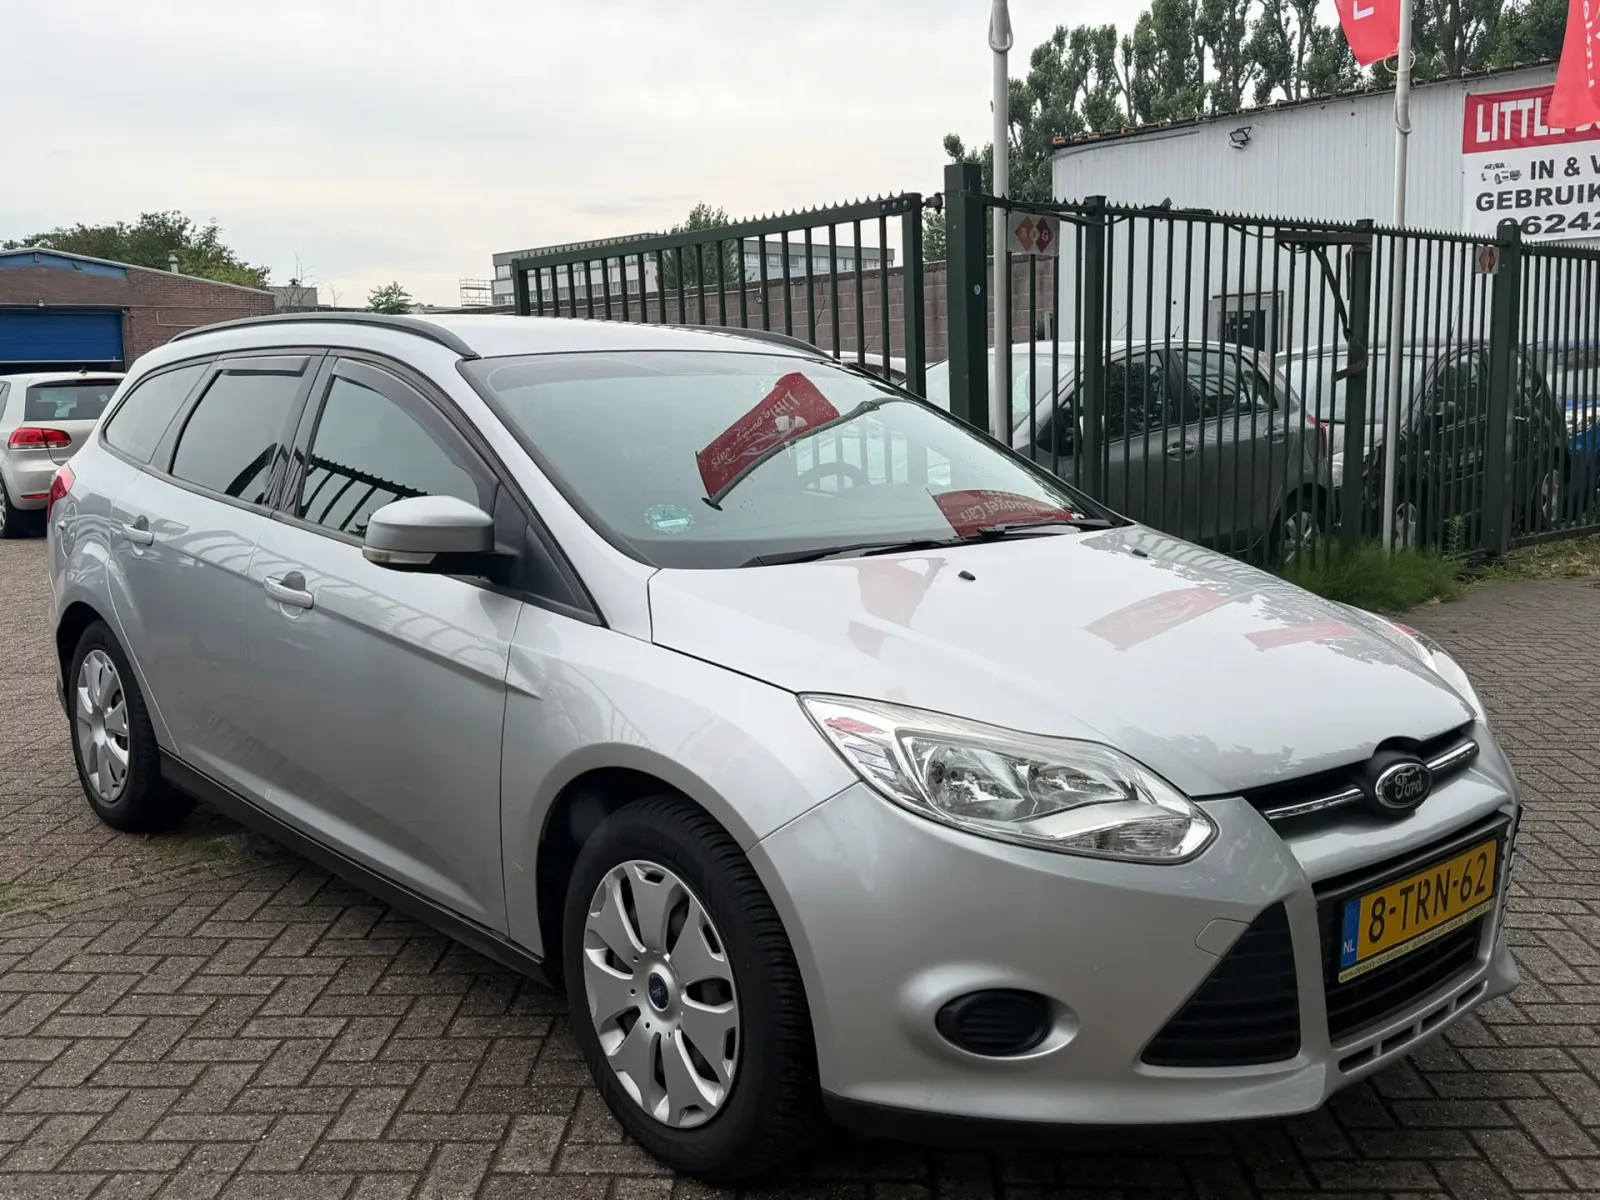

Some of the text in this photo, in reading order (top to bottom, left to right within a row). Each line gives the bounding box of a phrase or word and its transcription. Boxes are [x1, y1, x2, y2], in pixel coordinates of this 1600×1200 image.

[1476, 97, 1566, 143] LITTL
[1530, 159, 1554, 180] IN
[1564, 157, 1580, 177] &
[1394, 767, 1423, 799] Ford
[1368, 851, 1487, 943] 8-TRN-62
[1343, 938, 1355, 955] NL
